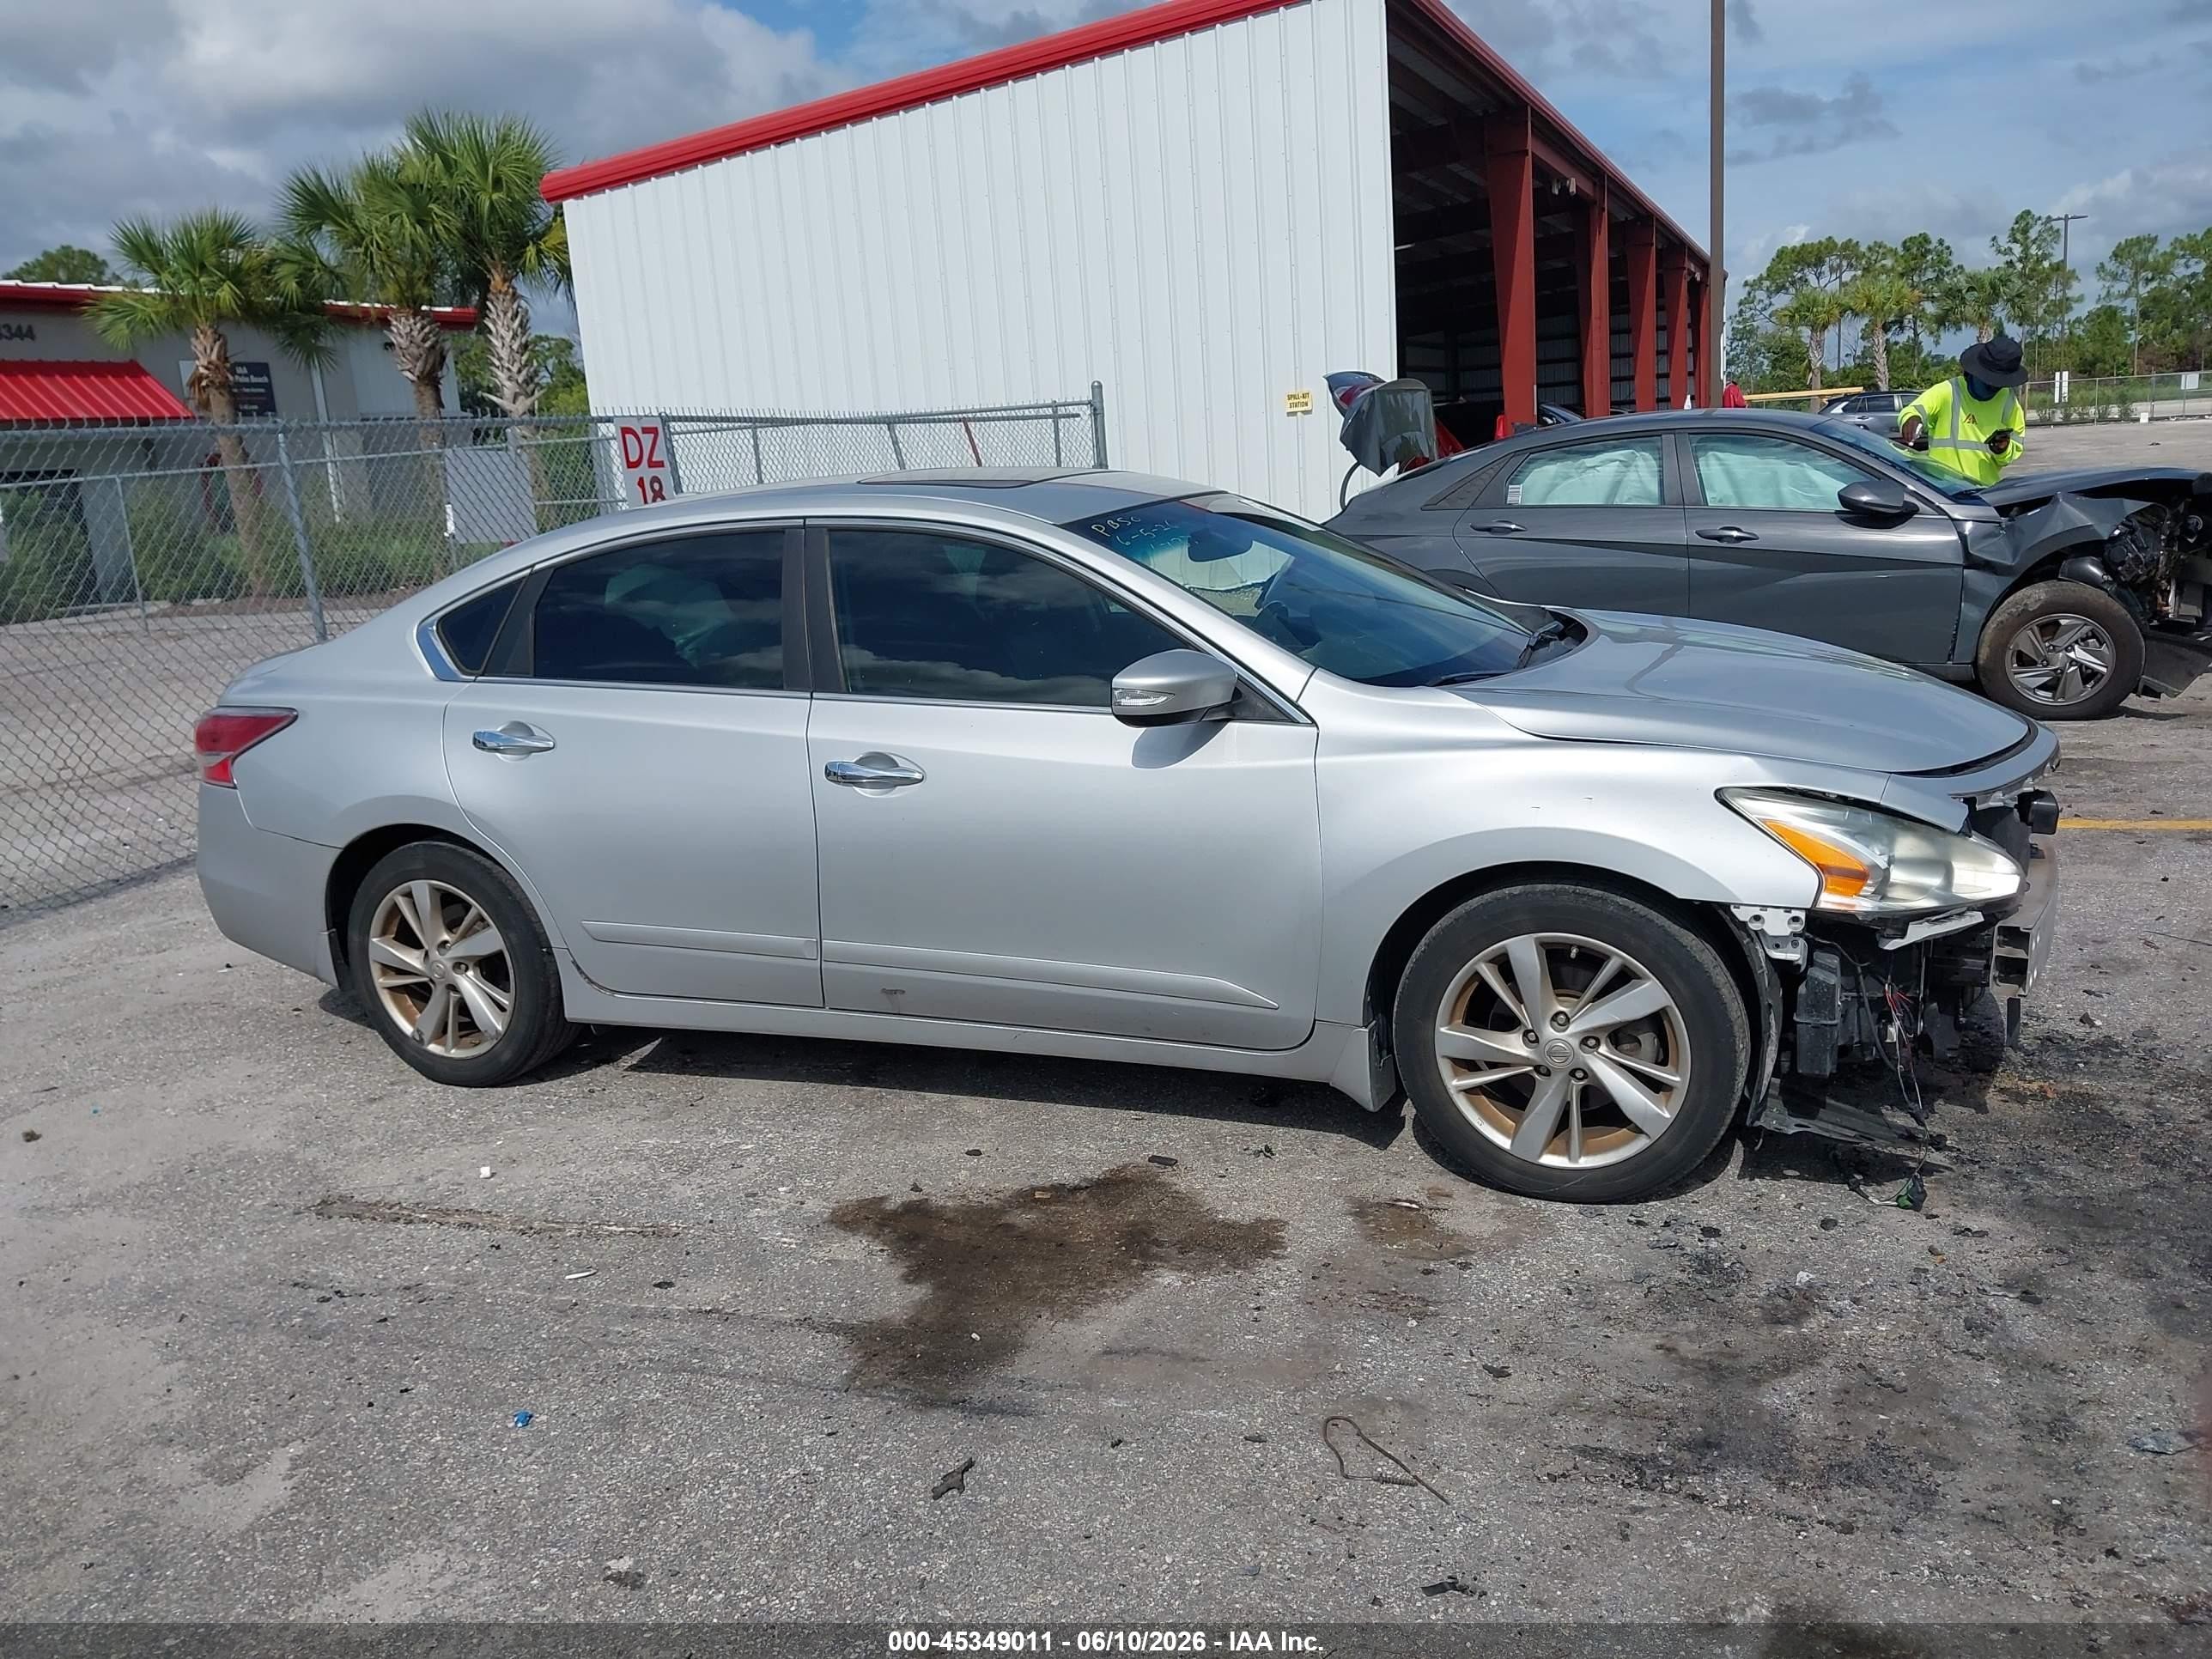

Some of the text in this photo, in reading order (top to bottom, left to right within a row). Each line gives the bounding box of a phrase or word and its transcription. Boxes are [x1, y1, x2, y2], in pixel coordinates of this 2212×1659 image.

[0, 323, 35, 341] 344
[620, 426, 665, 469] DZ
[637, 476, 666, 505] 18
